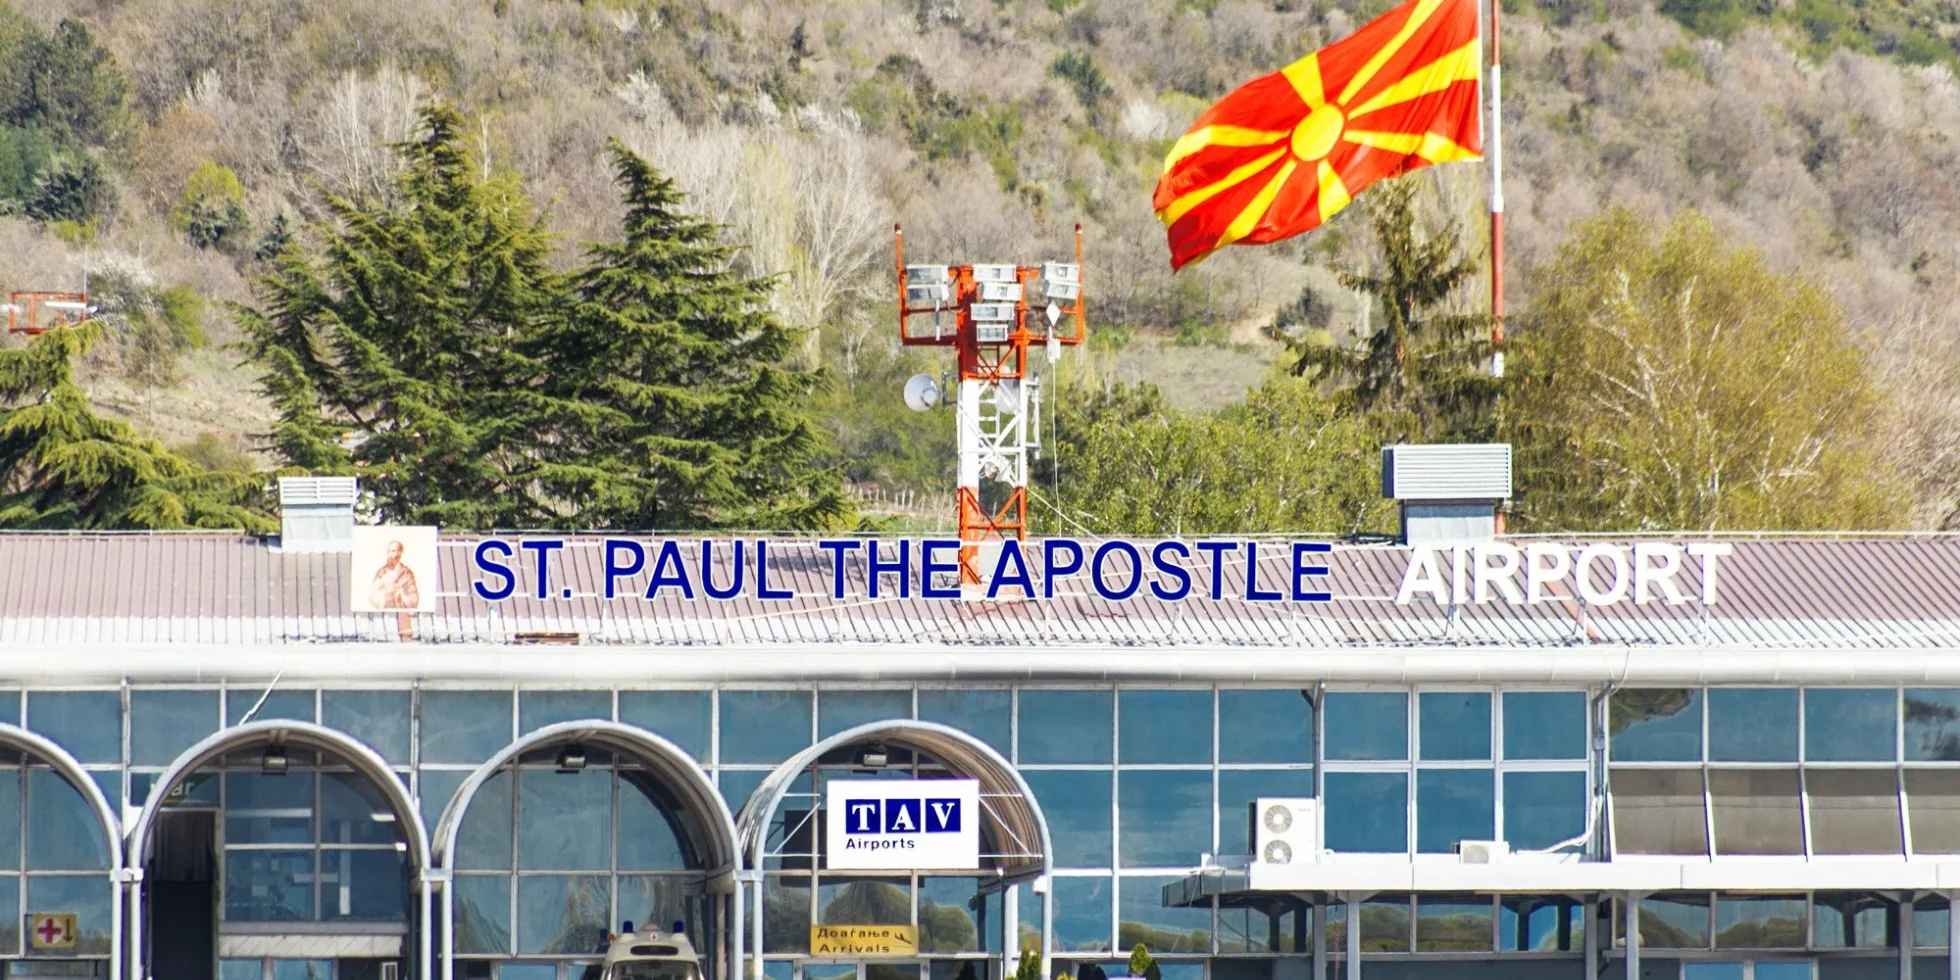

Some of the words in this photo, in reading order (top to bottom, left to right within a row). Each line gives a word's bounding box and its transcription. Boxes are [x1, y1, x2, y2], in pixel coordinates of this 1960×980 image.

[473, 540, 572, 600] ST.
[604, 540, 794, 600] PAUL
[818, 540, 962, 599] THE
[986, 540, 1332, 602] APOSTLE
[1396, 542, 1733, 606] AIRPORT
[850, 801, 957, 832] TAV
[845, 837, 916, 852] Airports
[818, 943, 890, 953] Arrivals
